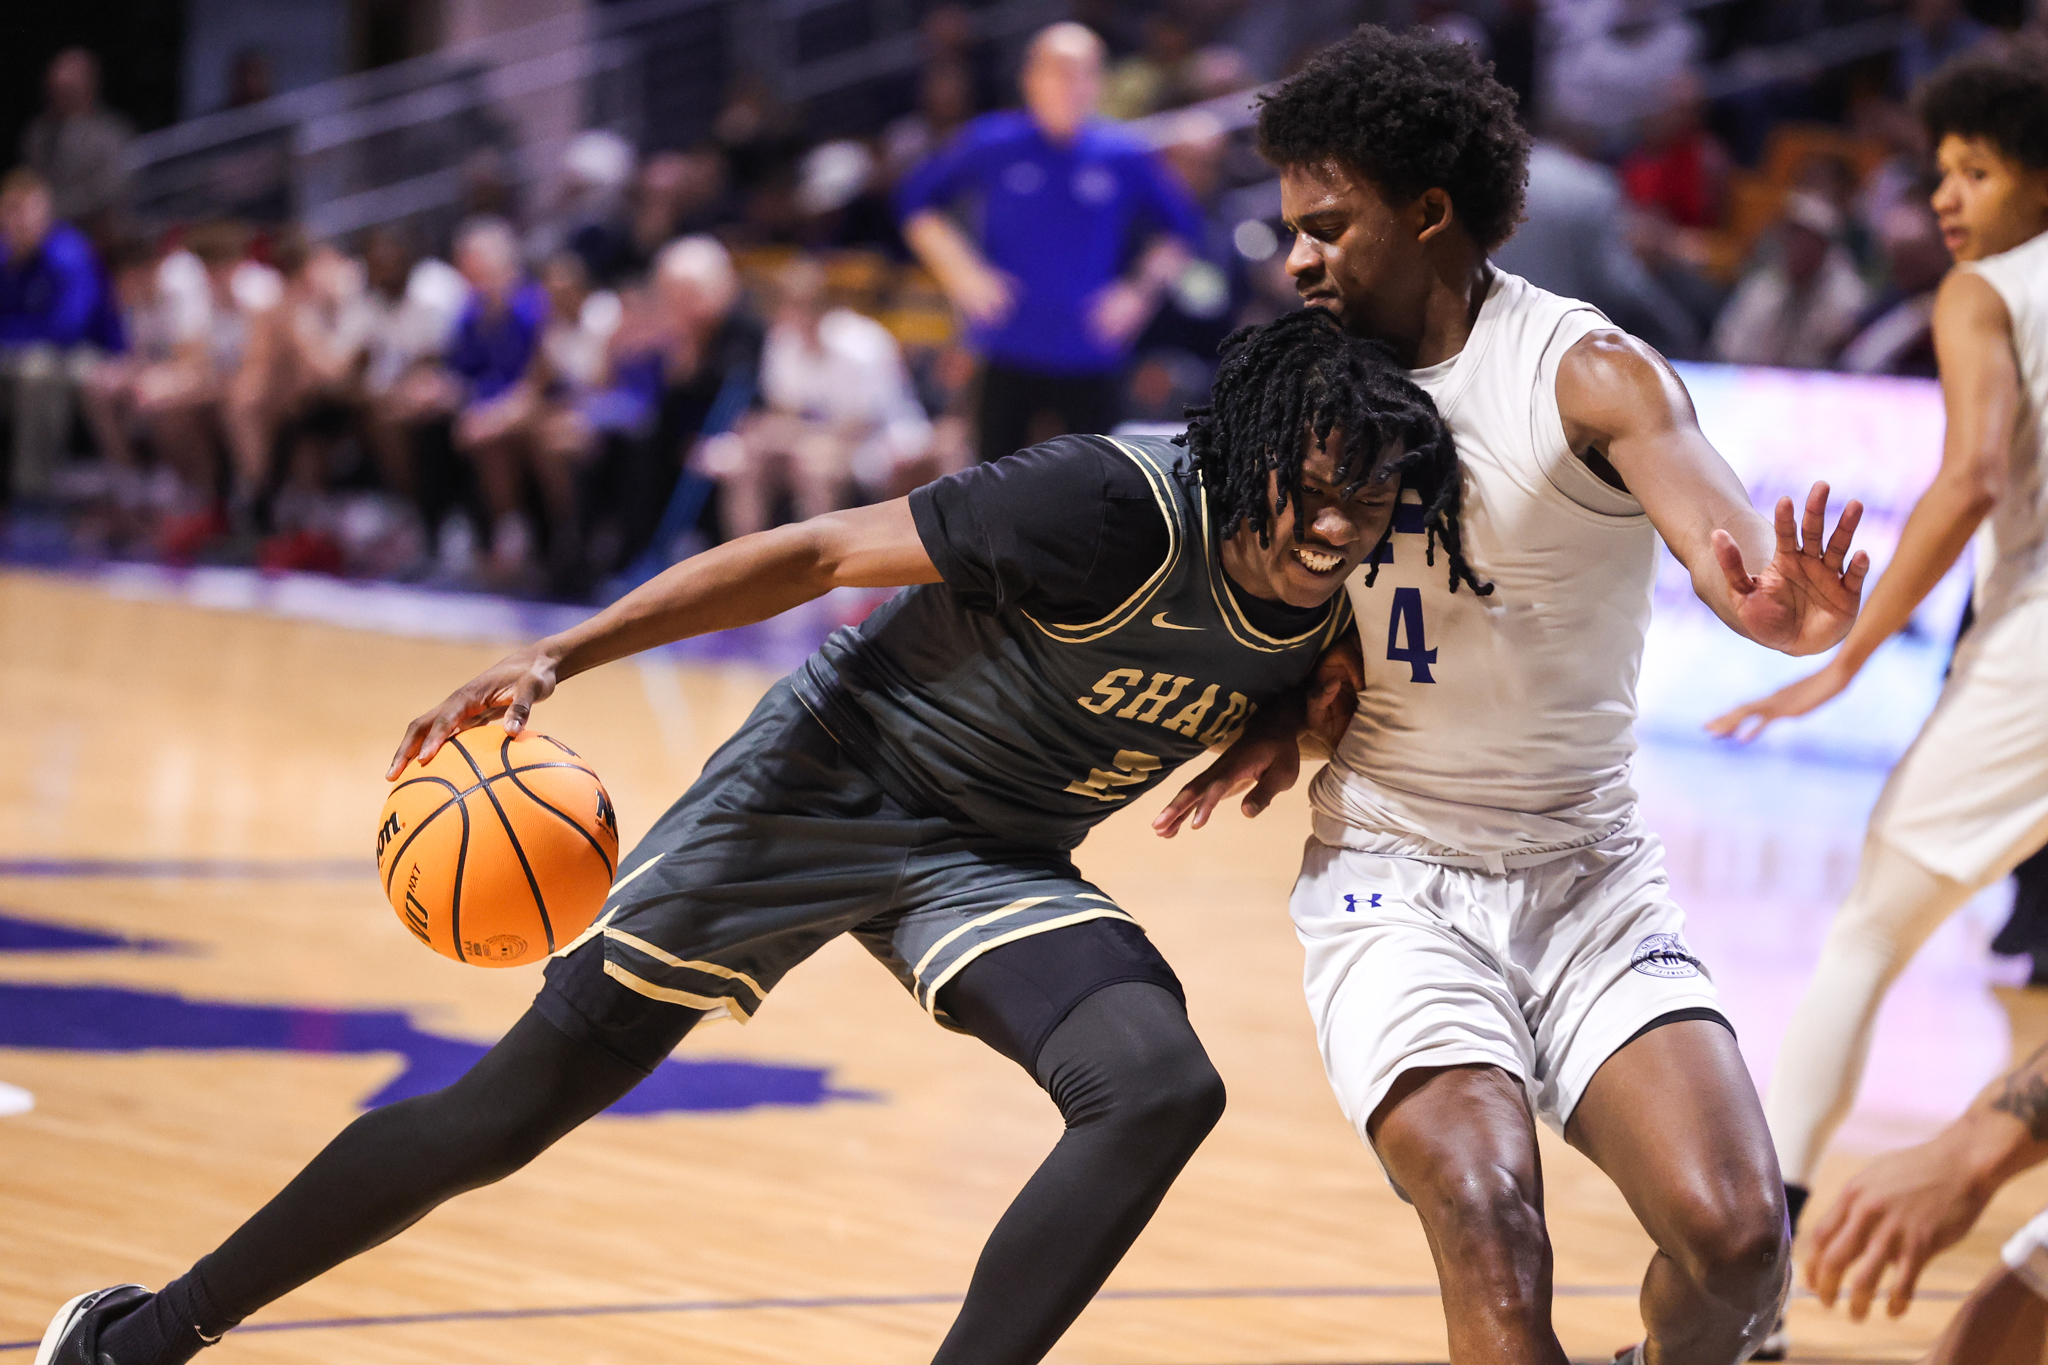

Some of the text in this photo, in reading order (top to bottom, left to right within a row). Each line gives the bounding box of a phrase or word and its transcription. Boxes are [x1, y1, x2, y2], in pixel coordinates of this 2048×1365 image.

[1386, 587, 1438, 684] 4
[1077, 668, 1257, 746] SHAD
[405, 862, 432, 944] VO NXT
